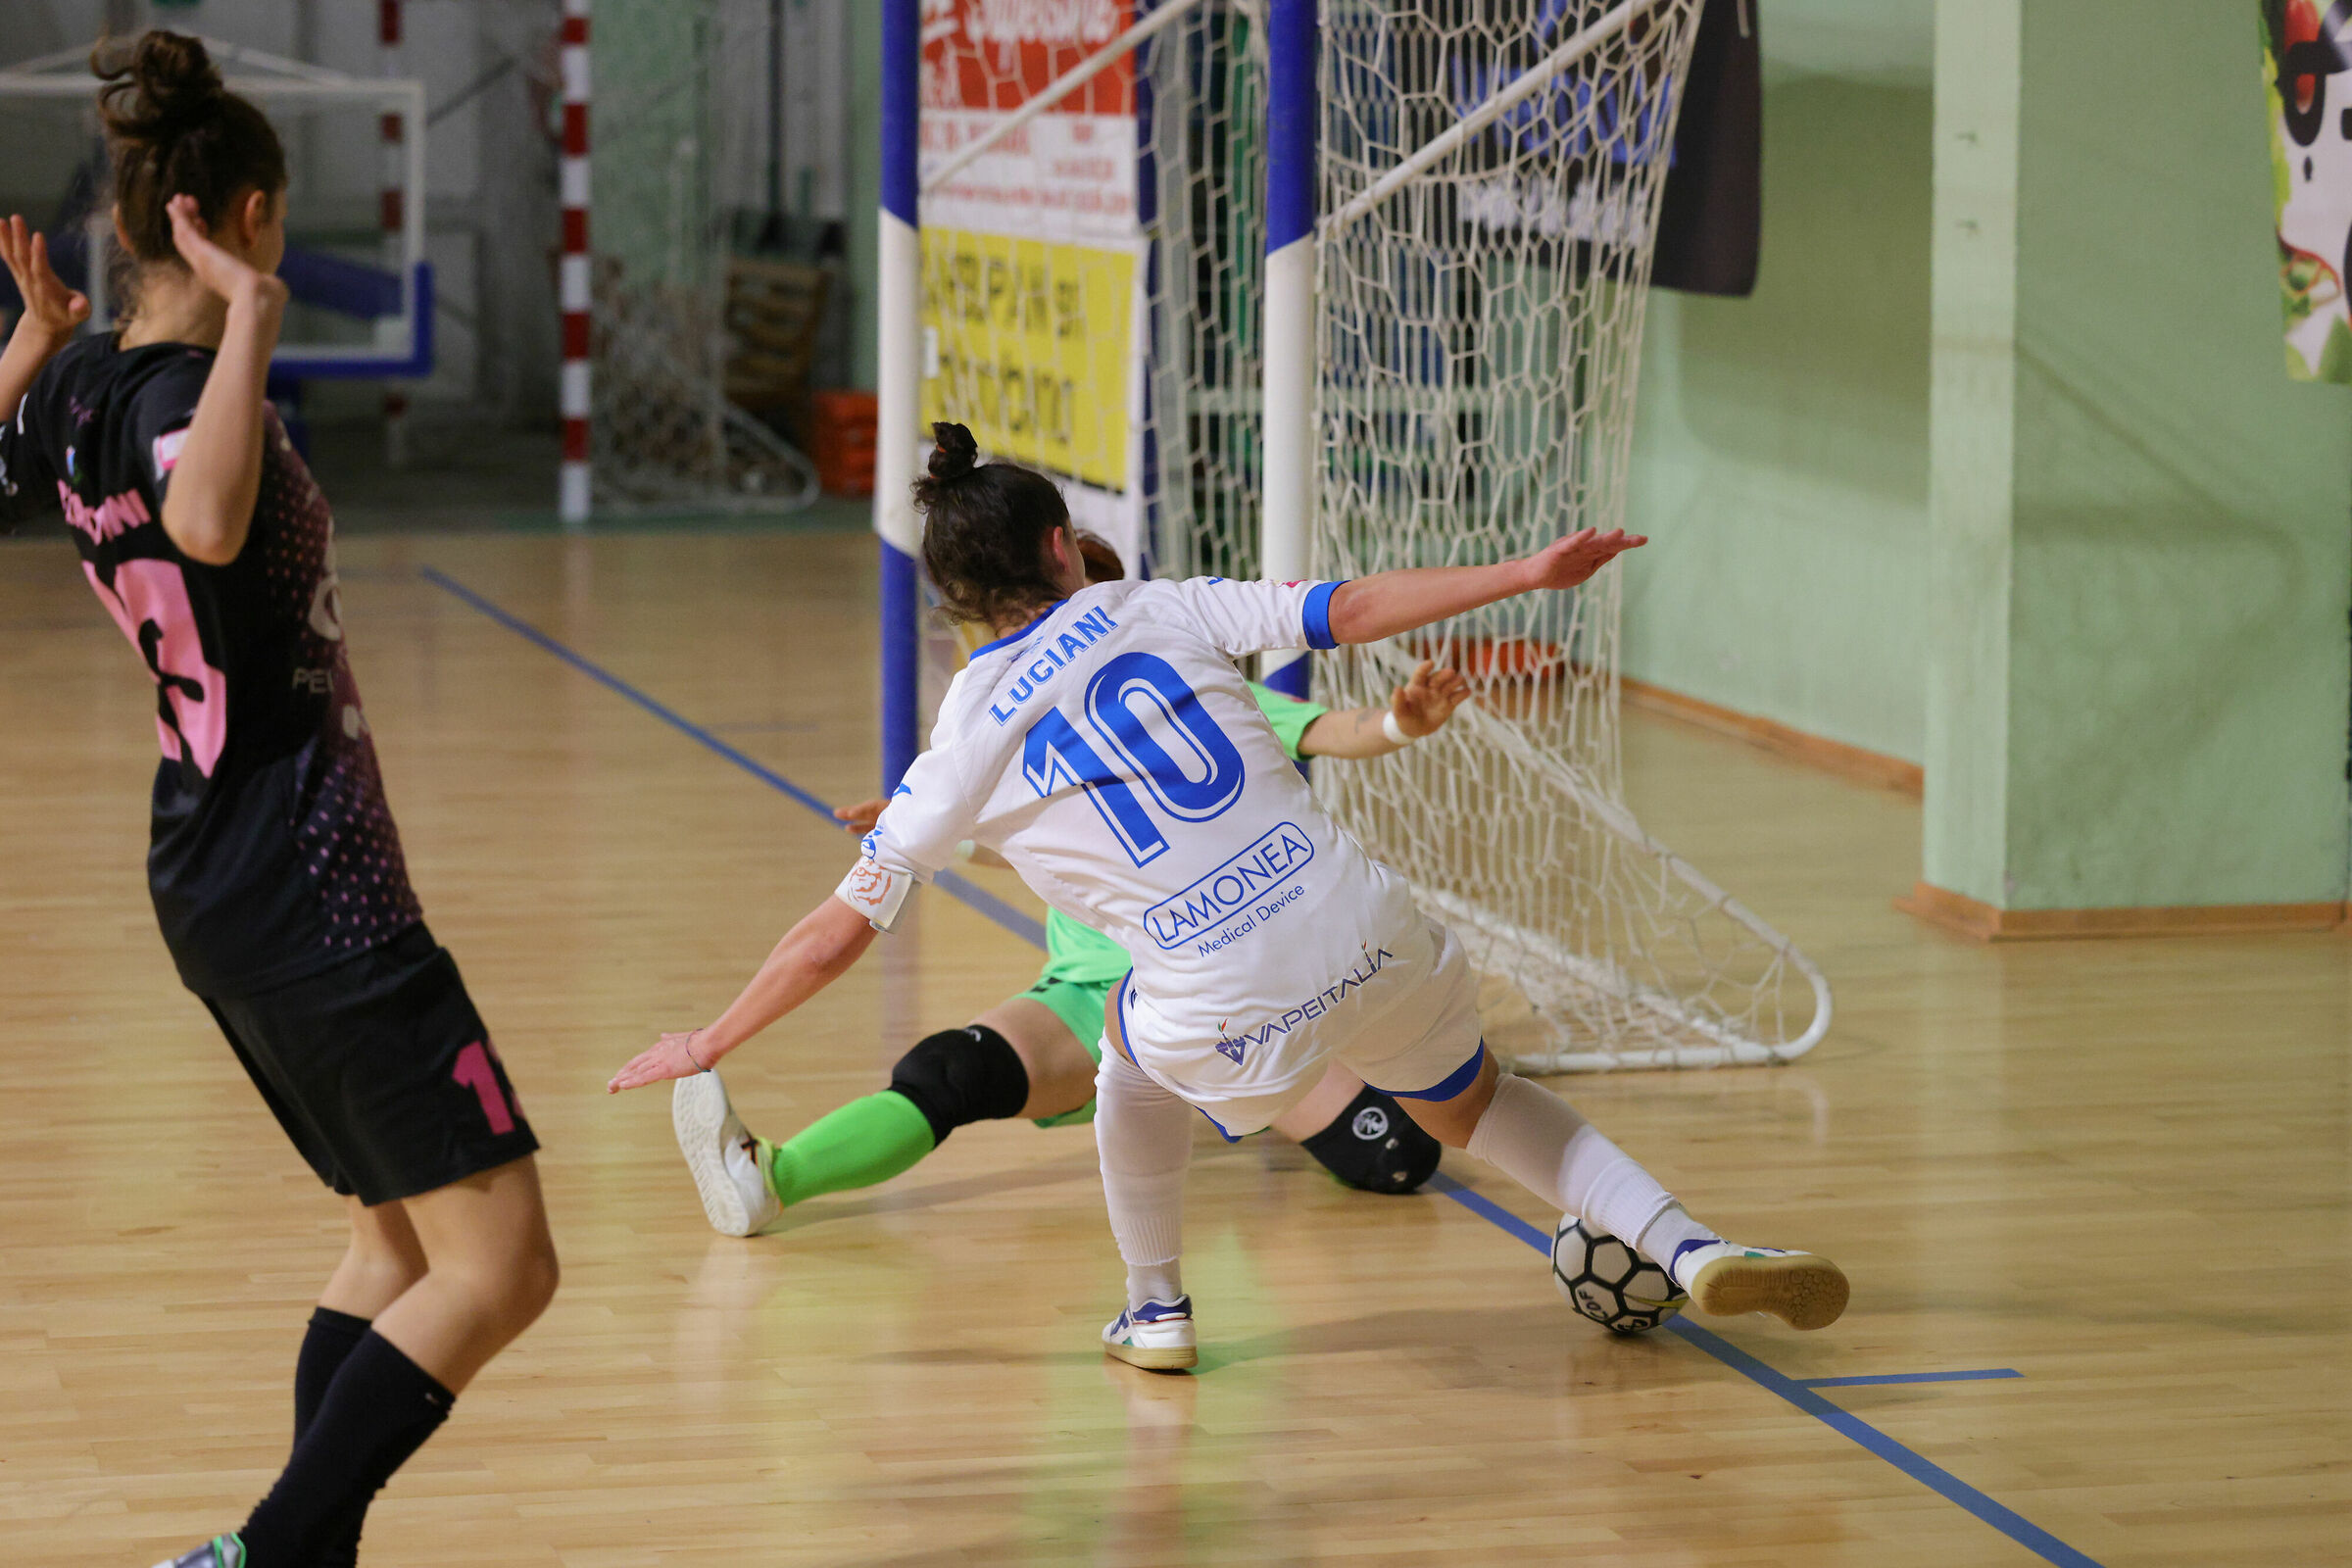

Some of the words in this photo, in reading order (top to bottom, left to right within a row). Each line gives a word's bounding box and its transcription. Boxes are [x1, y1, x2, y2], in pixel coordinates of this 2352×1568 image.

[989, 606, 1119, 727] LUCIANI
[1022, 652, 1245, 868] 10
[1152, 834, 1308, 943] LAMONEA
[1198, 913, 1256, 957] Medical
[1255, 885, 1304, 921] Device
[1244, 938, 1394, 1046] VAPEITALIA
